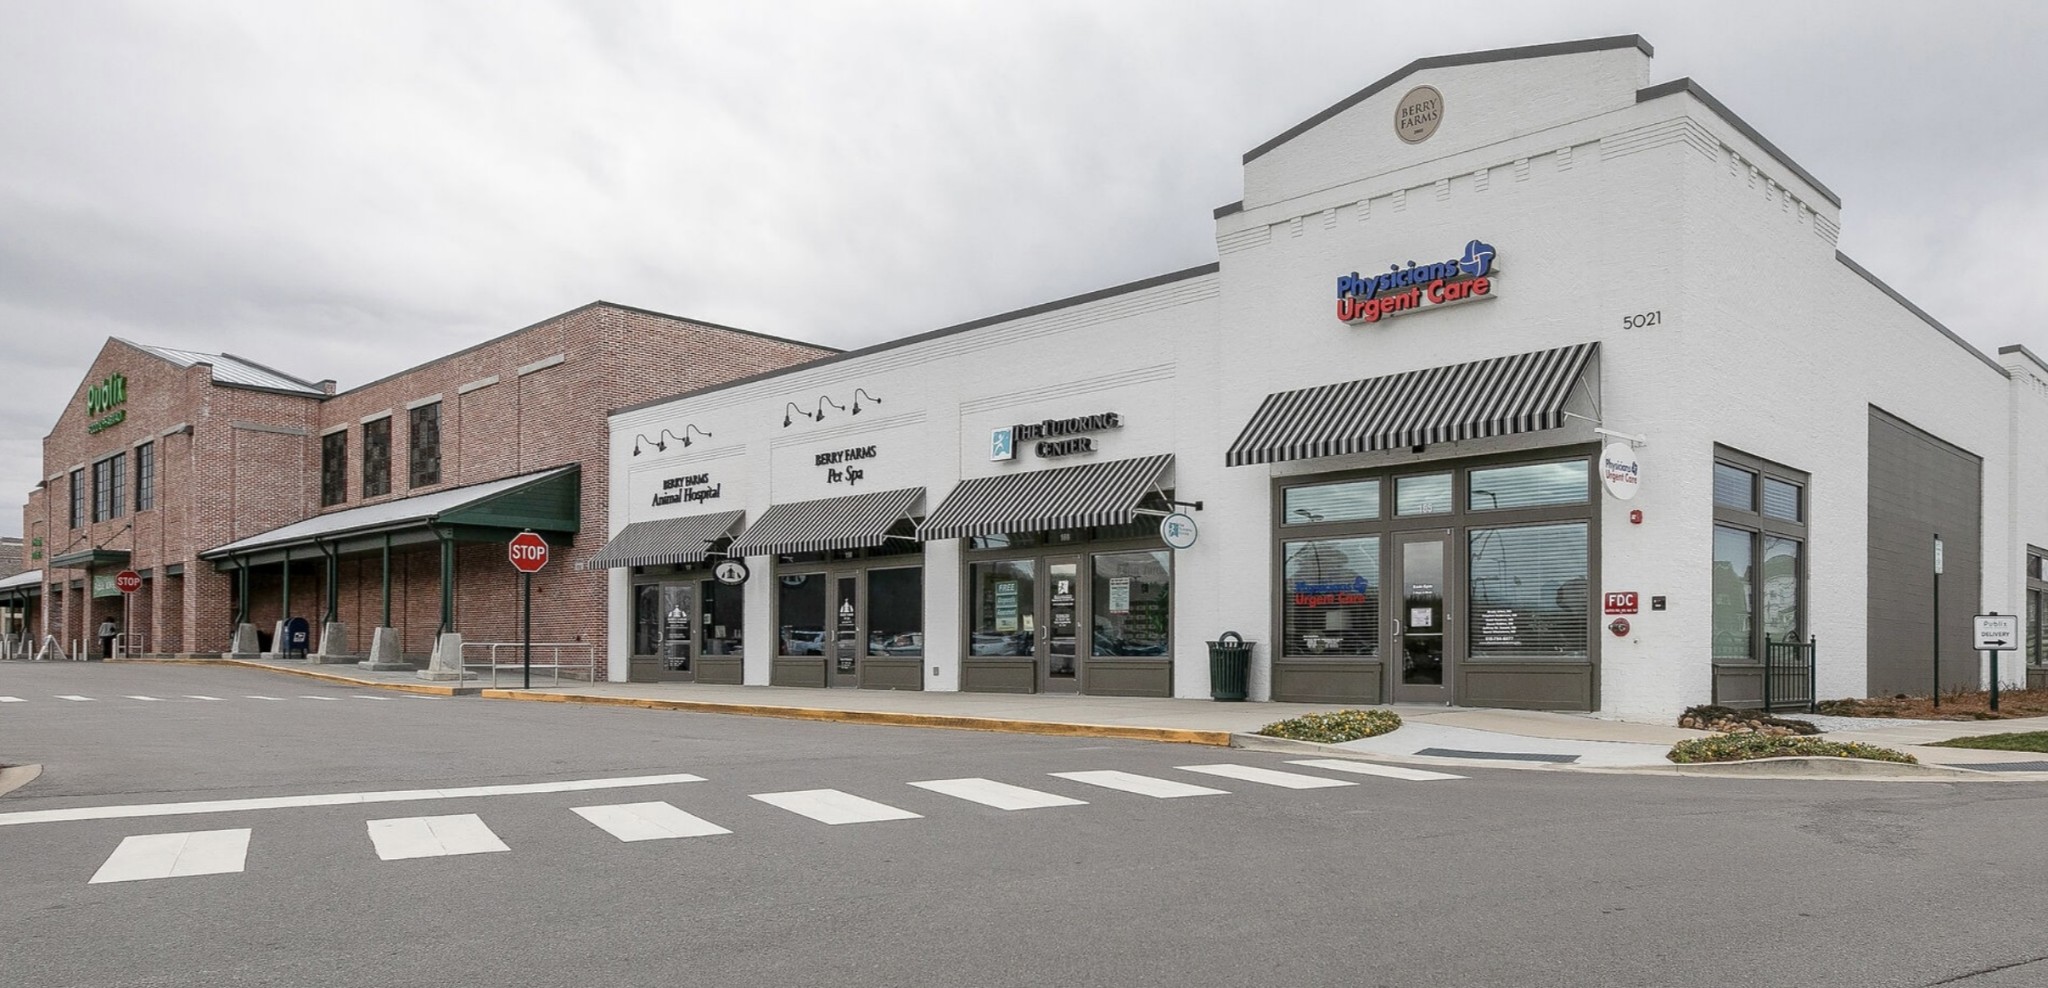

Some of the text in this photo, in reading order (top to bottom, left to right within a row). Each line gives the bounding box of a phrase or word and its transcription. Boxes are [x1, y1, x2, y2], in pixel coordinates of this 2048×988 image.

[1402, 98, 1438, 118] BERRY
[1401, 109, 1438, 129] FARMS
[1337, 260, 1459, 299] Physicians
[1337, 277, 1491, 322] Urgent Care
[1623, 310, 1661, 330] 5021
[1013, 412, 1120, 441] THE TUTORING
[815, 445, 877, 466] BERRY FARMS
[1035, 437, 1092, 458] CENTER
[827, 465, 864, 486] Pet Spa
[1605, 458, 1632, 473] Physicians
[663, 473, 709, 490] BERRY FARMS
[1605, 469, 1637, 484] Urgent Care
[651, 483, 721, 507] Animal Hospital
[512, 544, 546, 560] STOP
[117, 576, 140, 587] STOP
[998, 583, 1015, 592] FREE
[1337, 592, 1366, 605] Care
[1608, 594, 1634, 607] FDC
